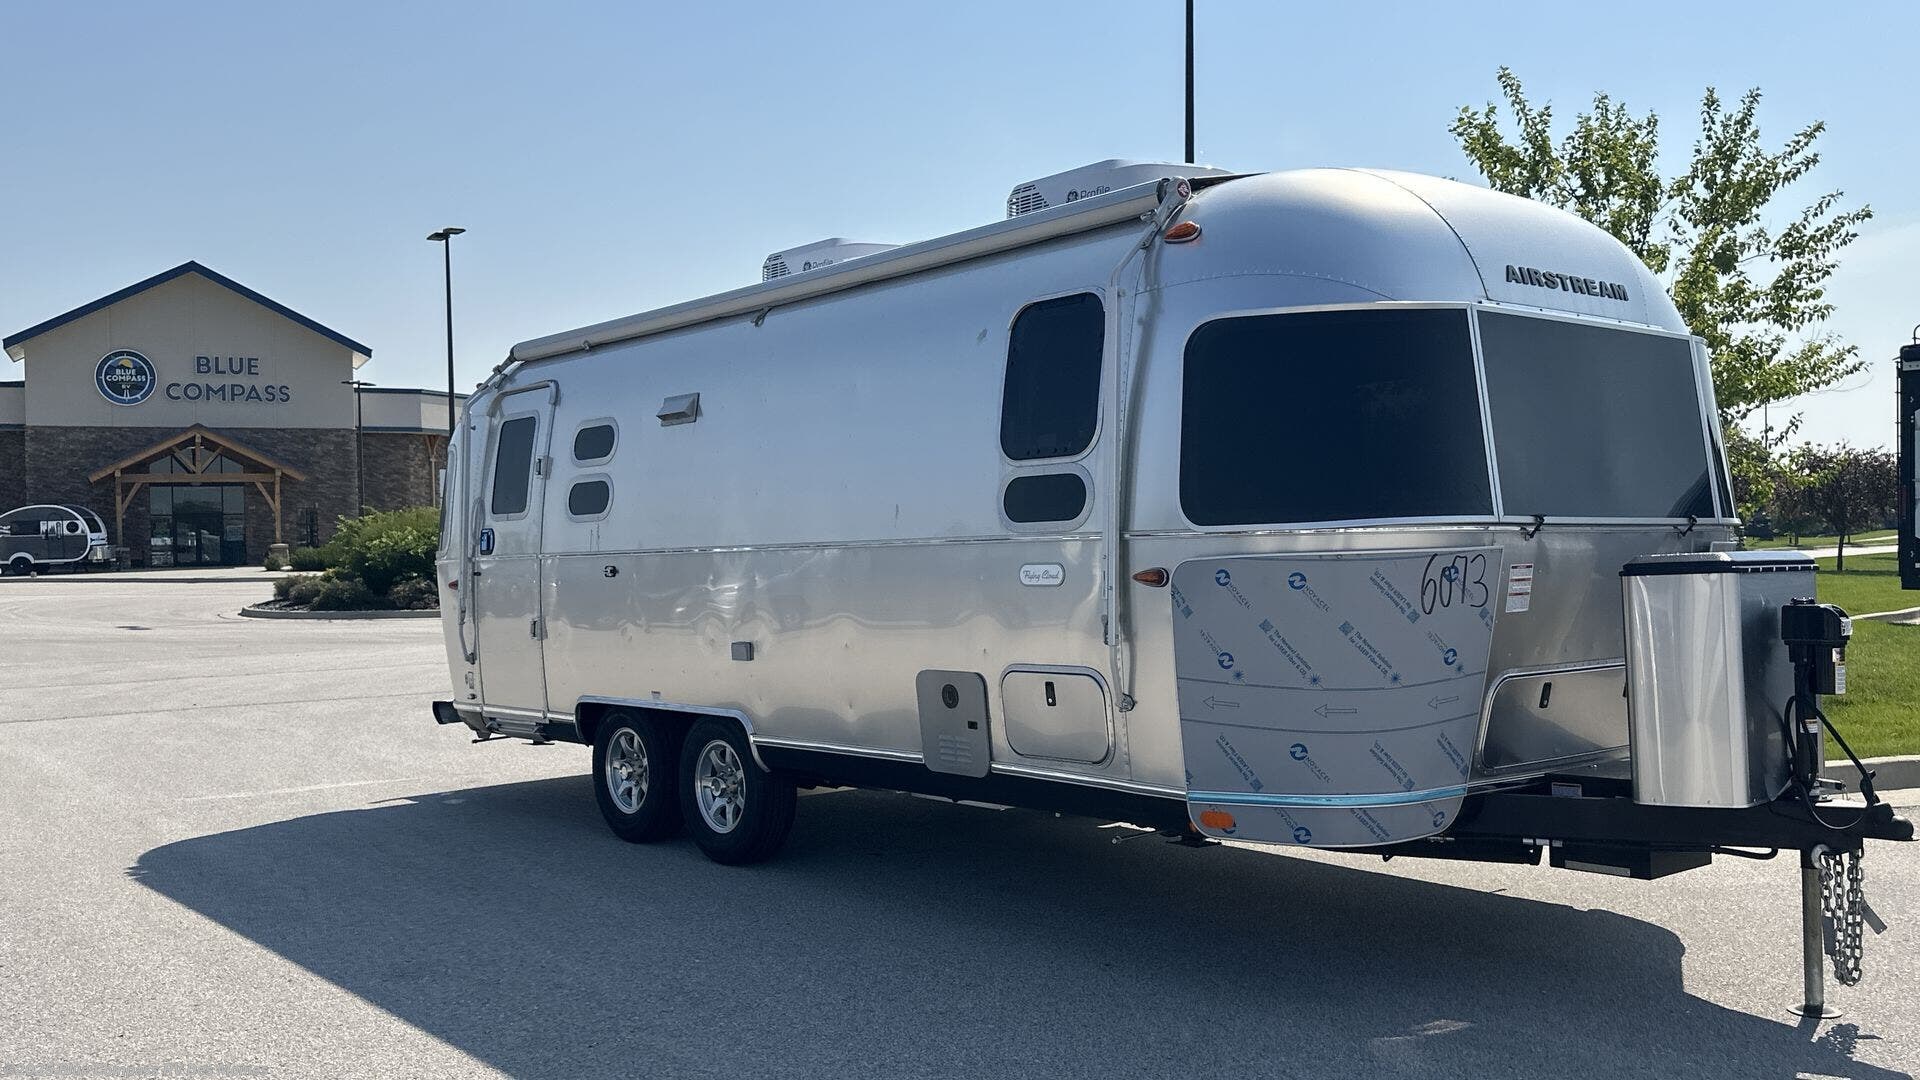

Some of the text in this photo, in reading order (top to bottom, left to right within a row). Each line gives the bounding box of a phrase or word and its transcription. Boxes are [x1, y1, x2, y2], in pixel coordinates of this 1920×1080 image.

[1080, 185, 1111, 199] Profile
[1505, 265, 1629, 301] AIRSTREAM
[115, 368, 137, 376] BLUE
[196, 356, 259, 375] BLUE
[165, 383, 290, 402] COMPASS
[1227, 583, 1252, 609] NOVACEL
[1304, 585, 1330, 611] NOVACEL
[1199, 629, 1222, 655] NOVACEL
[1305, 756, 1331, 783] NOVACEL
